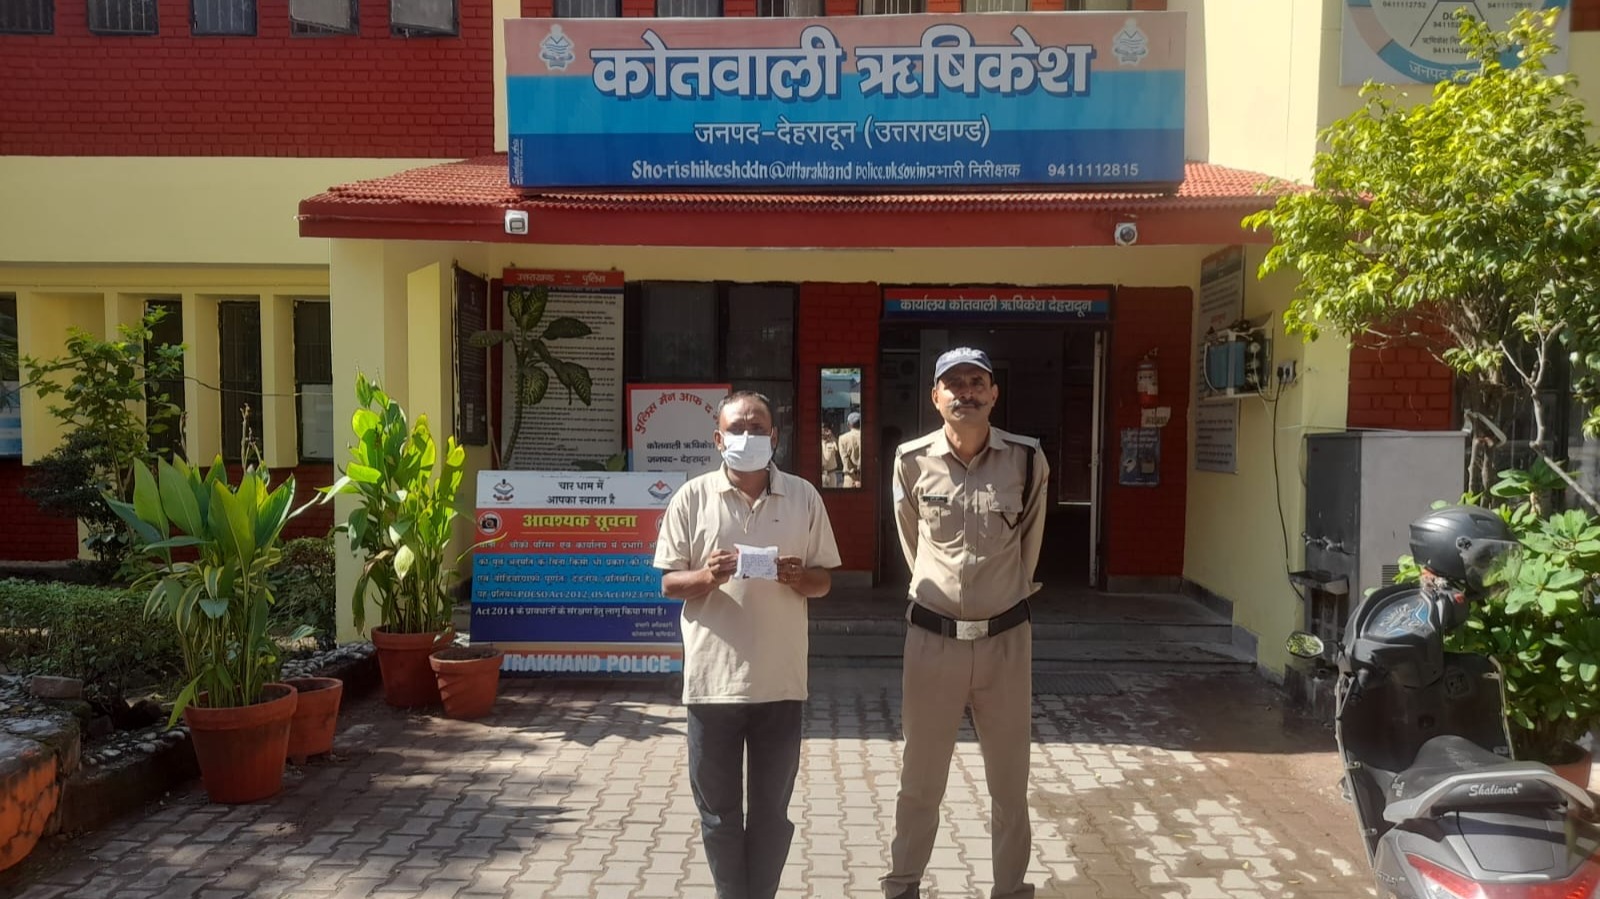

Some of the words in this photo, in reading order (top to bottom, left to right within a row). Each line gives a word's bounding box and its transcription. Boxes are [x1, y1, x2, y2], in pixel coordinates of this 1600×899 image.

[590, 25, 844, 101] कोतवाली
[855, 24, 1094, 96] ऋषिकेश
[1408, 60, 1448, 81] जनपद
[864, 114, 990, 149] (उत्तराखण्ड)
[968, 160, 1021, 179] निरीक्षक
[1048, 163, 1139, 177] 9411112815
[900, 294, 946, 312] कार्यालय
[949, 294, 997, 312] कोतवाली
[1000, 295, 1046, 312] ऋषिकेश
[1048, 298, 1092, 317] देहरादून
[635, 402, 657, 434] पुलिस
[646, 439, 681, 450] कोतवाली
[680, 453, 711, 466] देहरादून
[558, 480, 574, 491] चार
[576, 480, 594, 491] धाम
[546, 495, 576, 506] आपका
[579, 495, 607, 506] स्वागत
[609, 492, 616, 506] है
[523, 514, 591, 528] आवश्यक
[595, 514, 638, 532] सूचना
[475, 606, 490, 615] Act
[491, 607, 514, 615] 2014
[502, 654, 600, 672] TRAKHAND
[606, 654, 672, 673] POLICE
